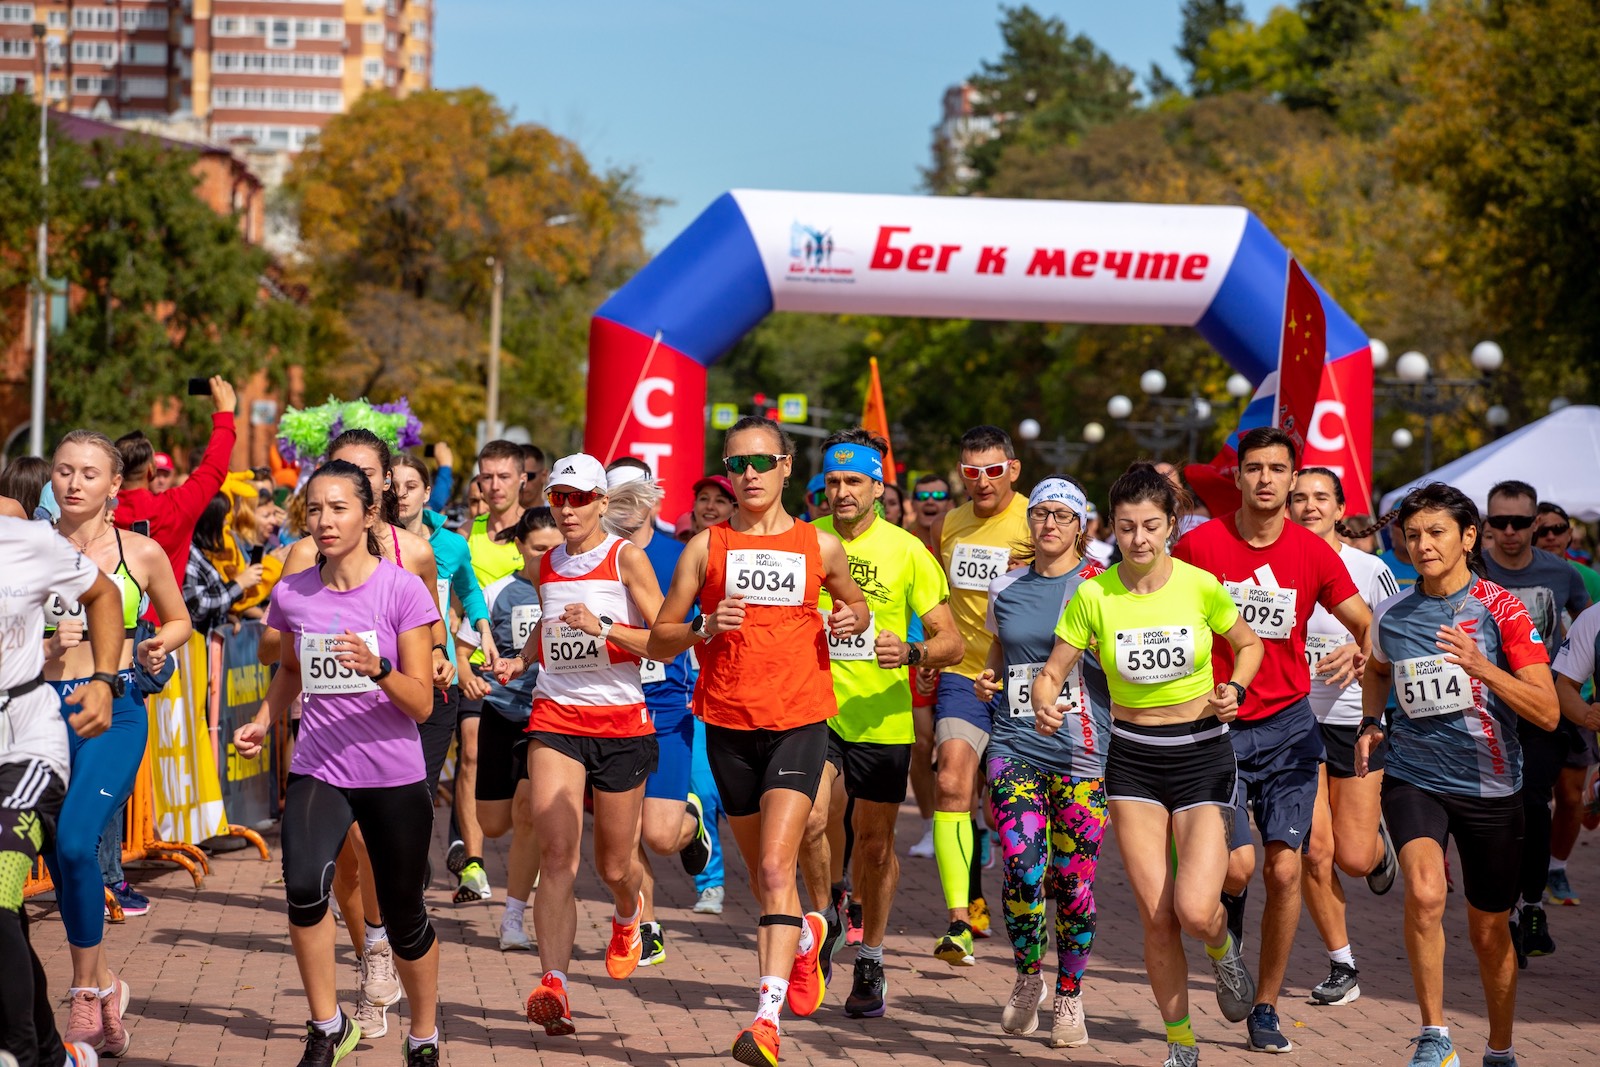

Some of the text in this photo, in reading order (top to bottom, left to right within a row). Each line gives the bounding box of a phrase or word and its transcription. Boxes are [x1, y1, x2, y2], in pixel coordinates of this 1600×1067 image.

[869, 225, 1210, 281] Бег к мечте
[956, 560, 998, 580] 5036
[736, 569, 795, 592] 5034
[52, 596, 82, 616] 50
[1248, 595, 1274, 603] НАЦИИ
[519, 621, 537, 637] 50
[825, 629, 866, 648] 046
[550, 640, 598, 661] 5024
[1143, 637, 1170, 645] НАЦИИ
[1127, 646, 1186, 671] 5303
[1415, 660, 1436, 668] КРОСС
[1416, 666, 1443, 676] НАЦИИ
[1018, 681, 1072, 704] 54
[1404, 675, 1461, 704] 5114
